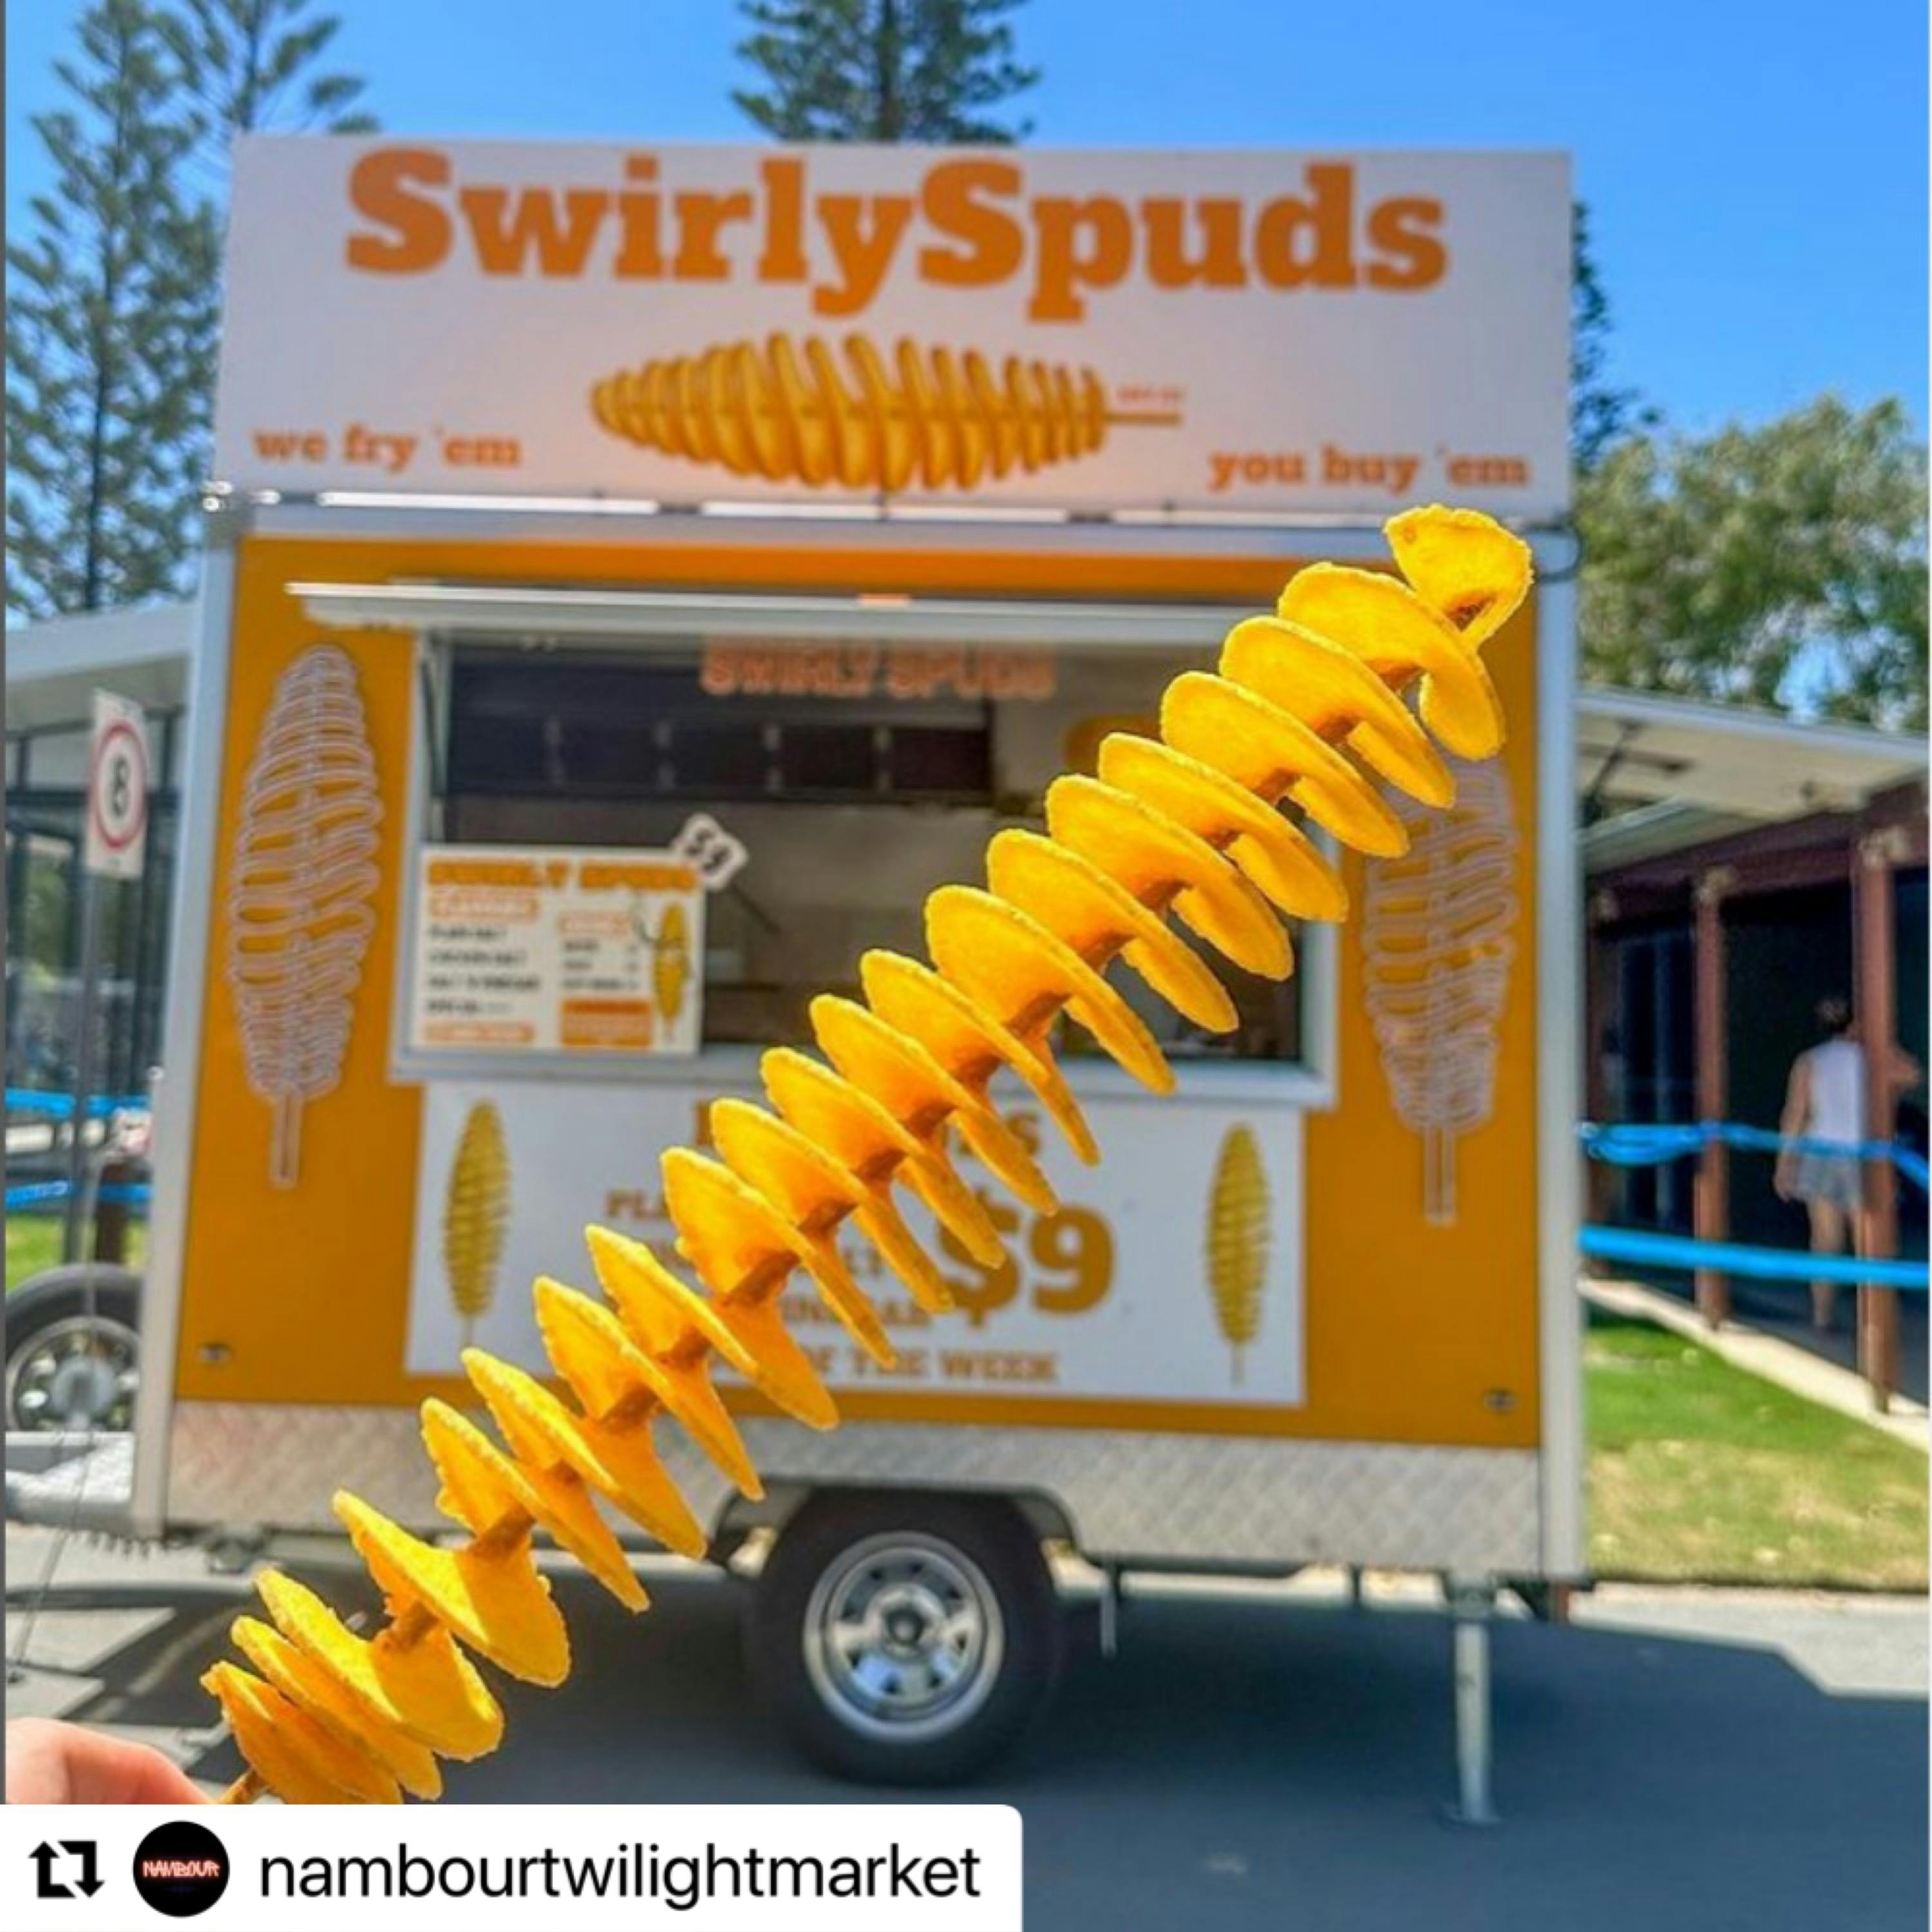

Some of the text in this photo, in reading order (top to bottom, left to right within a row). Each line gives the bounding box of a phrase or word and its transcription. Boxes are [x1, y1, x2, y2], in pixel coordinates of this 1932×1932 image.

[346, 147, 1448, 322] SwirlySpuds
[254, 430, 327, 460] we
[343, 422, 417, 475] fry
[1211, 451, 1303, 493] you
[1321, 447, 1421, 495] buy
[937, 1188, 1115, 1328] $9
[939, 1349, 1056, 1382] WEEK
